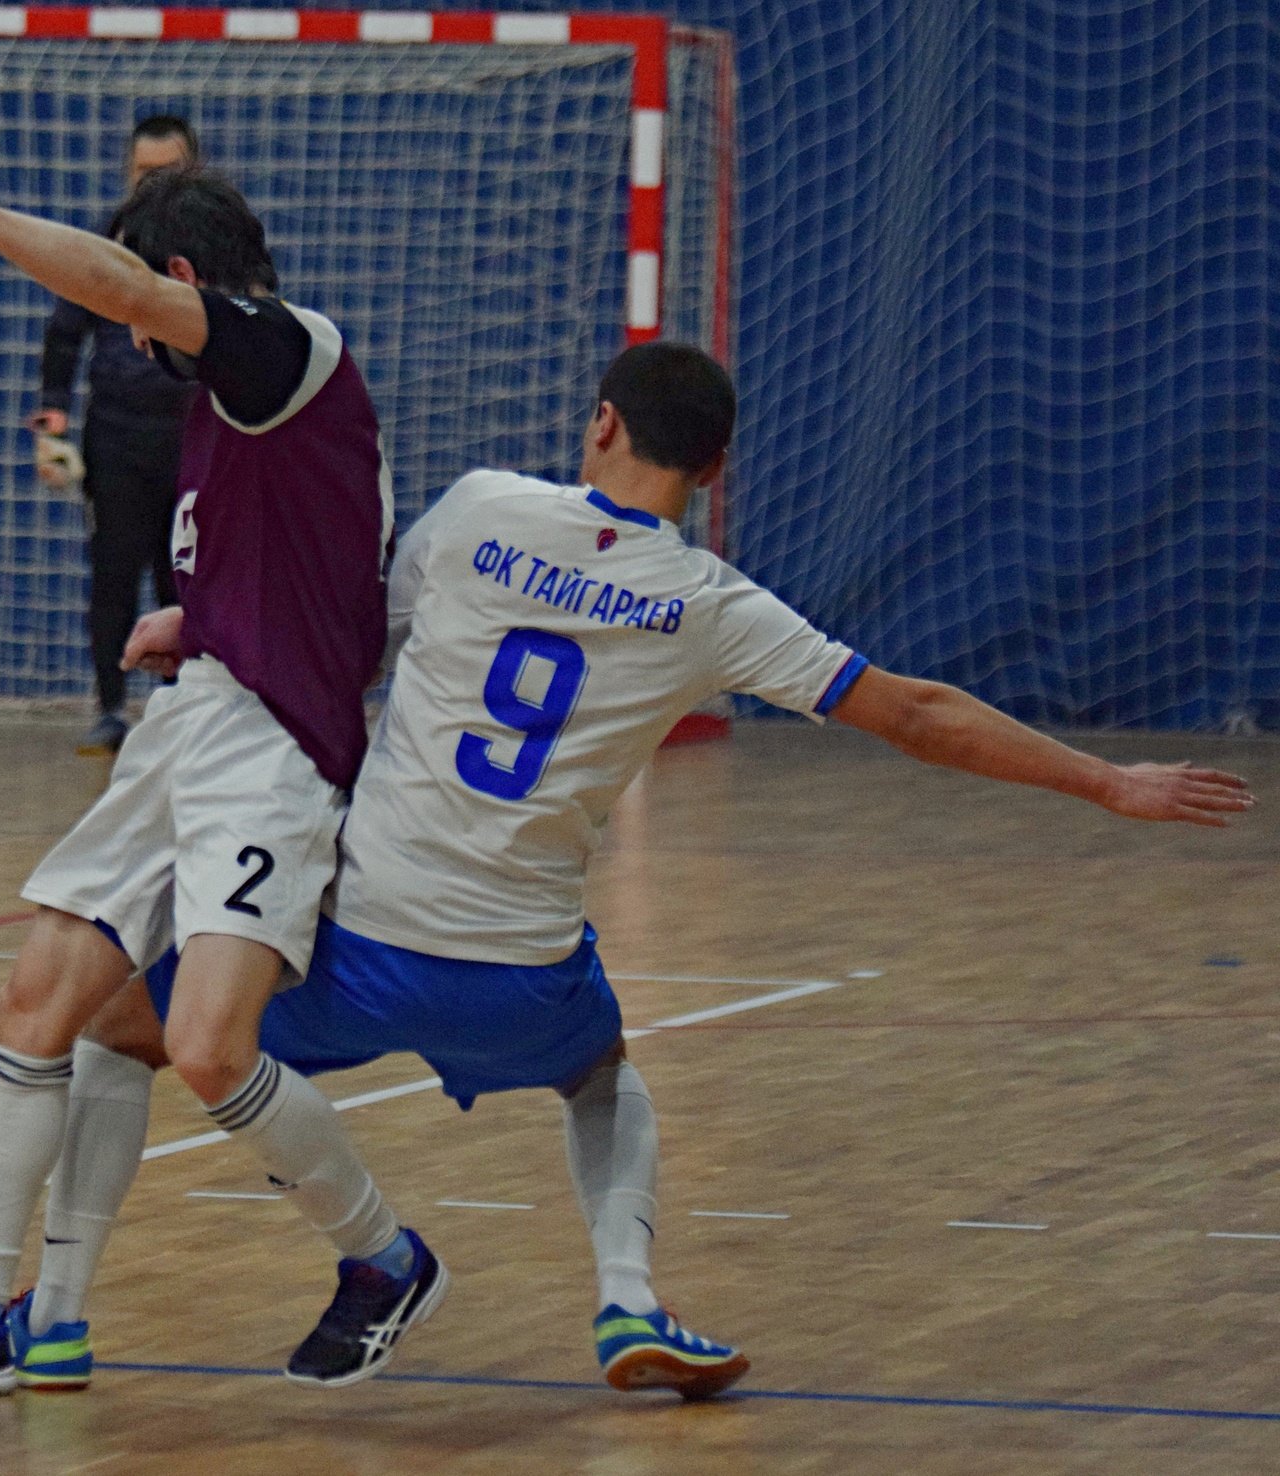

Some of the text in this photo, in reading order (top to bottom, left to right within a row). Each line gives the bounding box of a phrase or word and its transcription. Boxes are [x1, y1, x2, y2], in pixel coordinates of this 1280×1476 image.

[473, 539, 686, 635] ФК ТАЙГАРАЕВ
[455, 627, 590, 802] 9
[223, 845, 276, 919] 2
